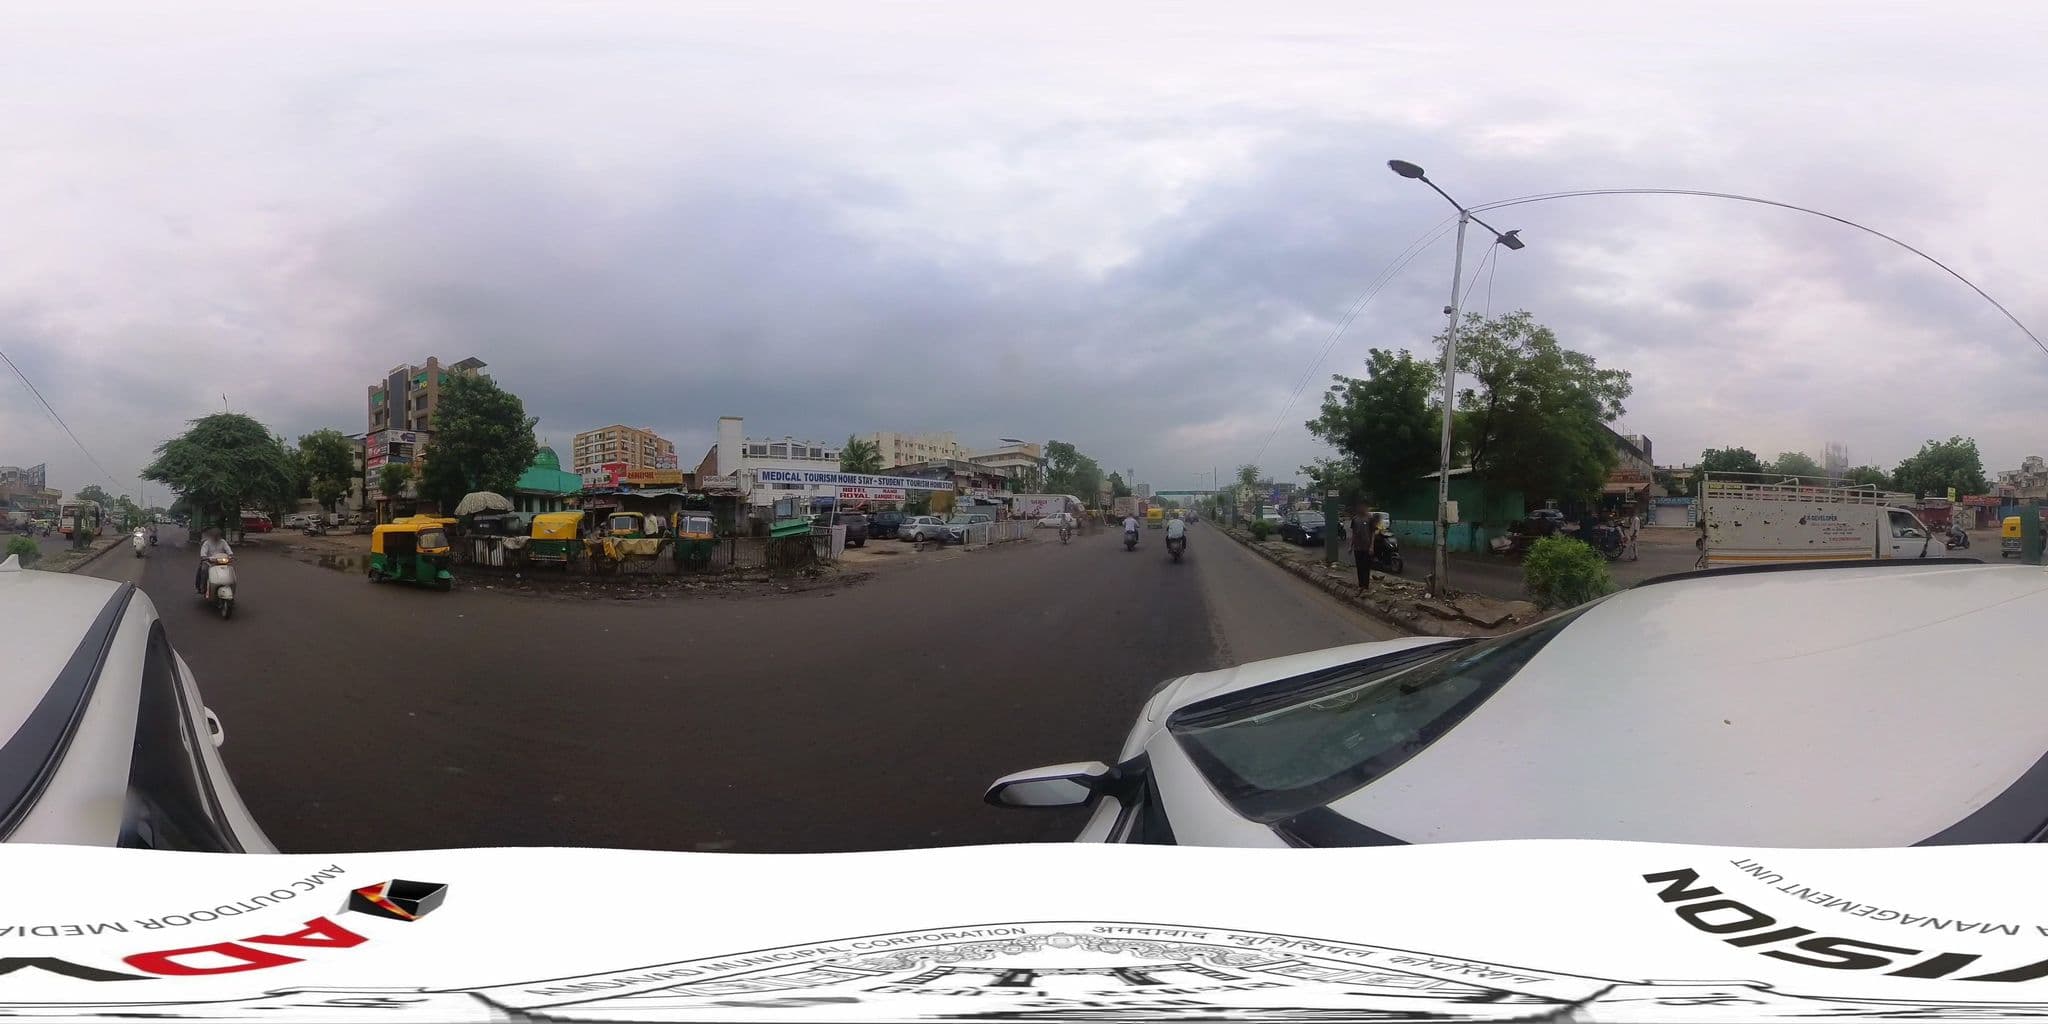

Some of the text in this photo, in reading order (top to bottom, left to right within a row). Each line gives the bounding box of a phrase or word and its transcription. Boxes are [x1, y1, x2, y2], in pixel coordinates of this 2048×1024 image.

[762, 471, 802, 482] MEDICAL
[804, 473, 837, 483] TOURISM
[838, 474, 857, 484] HOME
[858, 476, 873, 485] STAY
[879, 477, 904, 487] STUDENT
